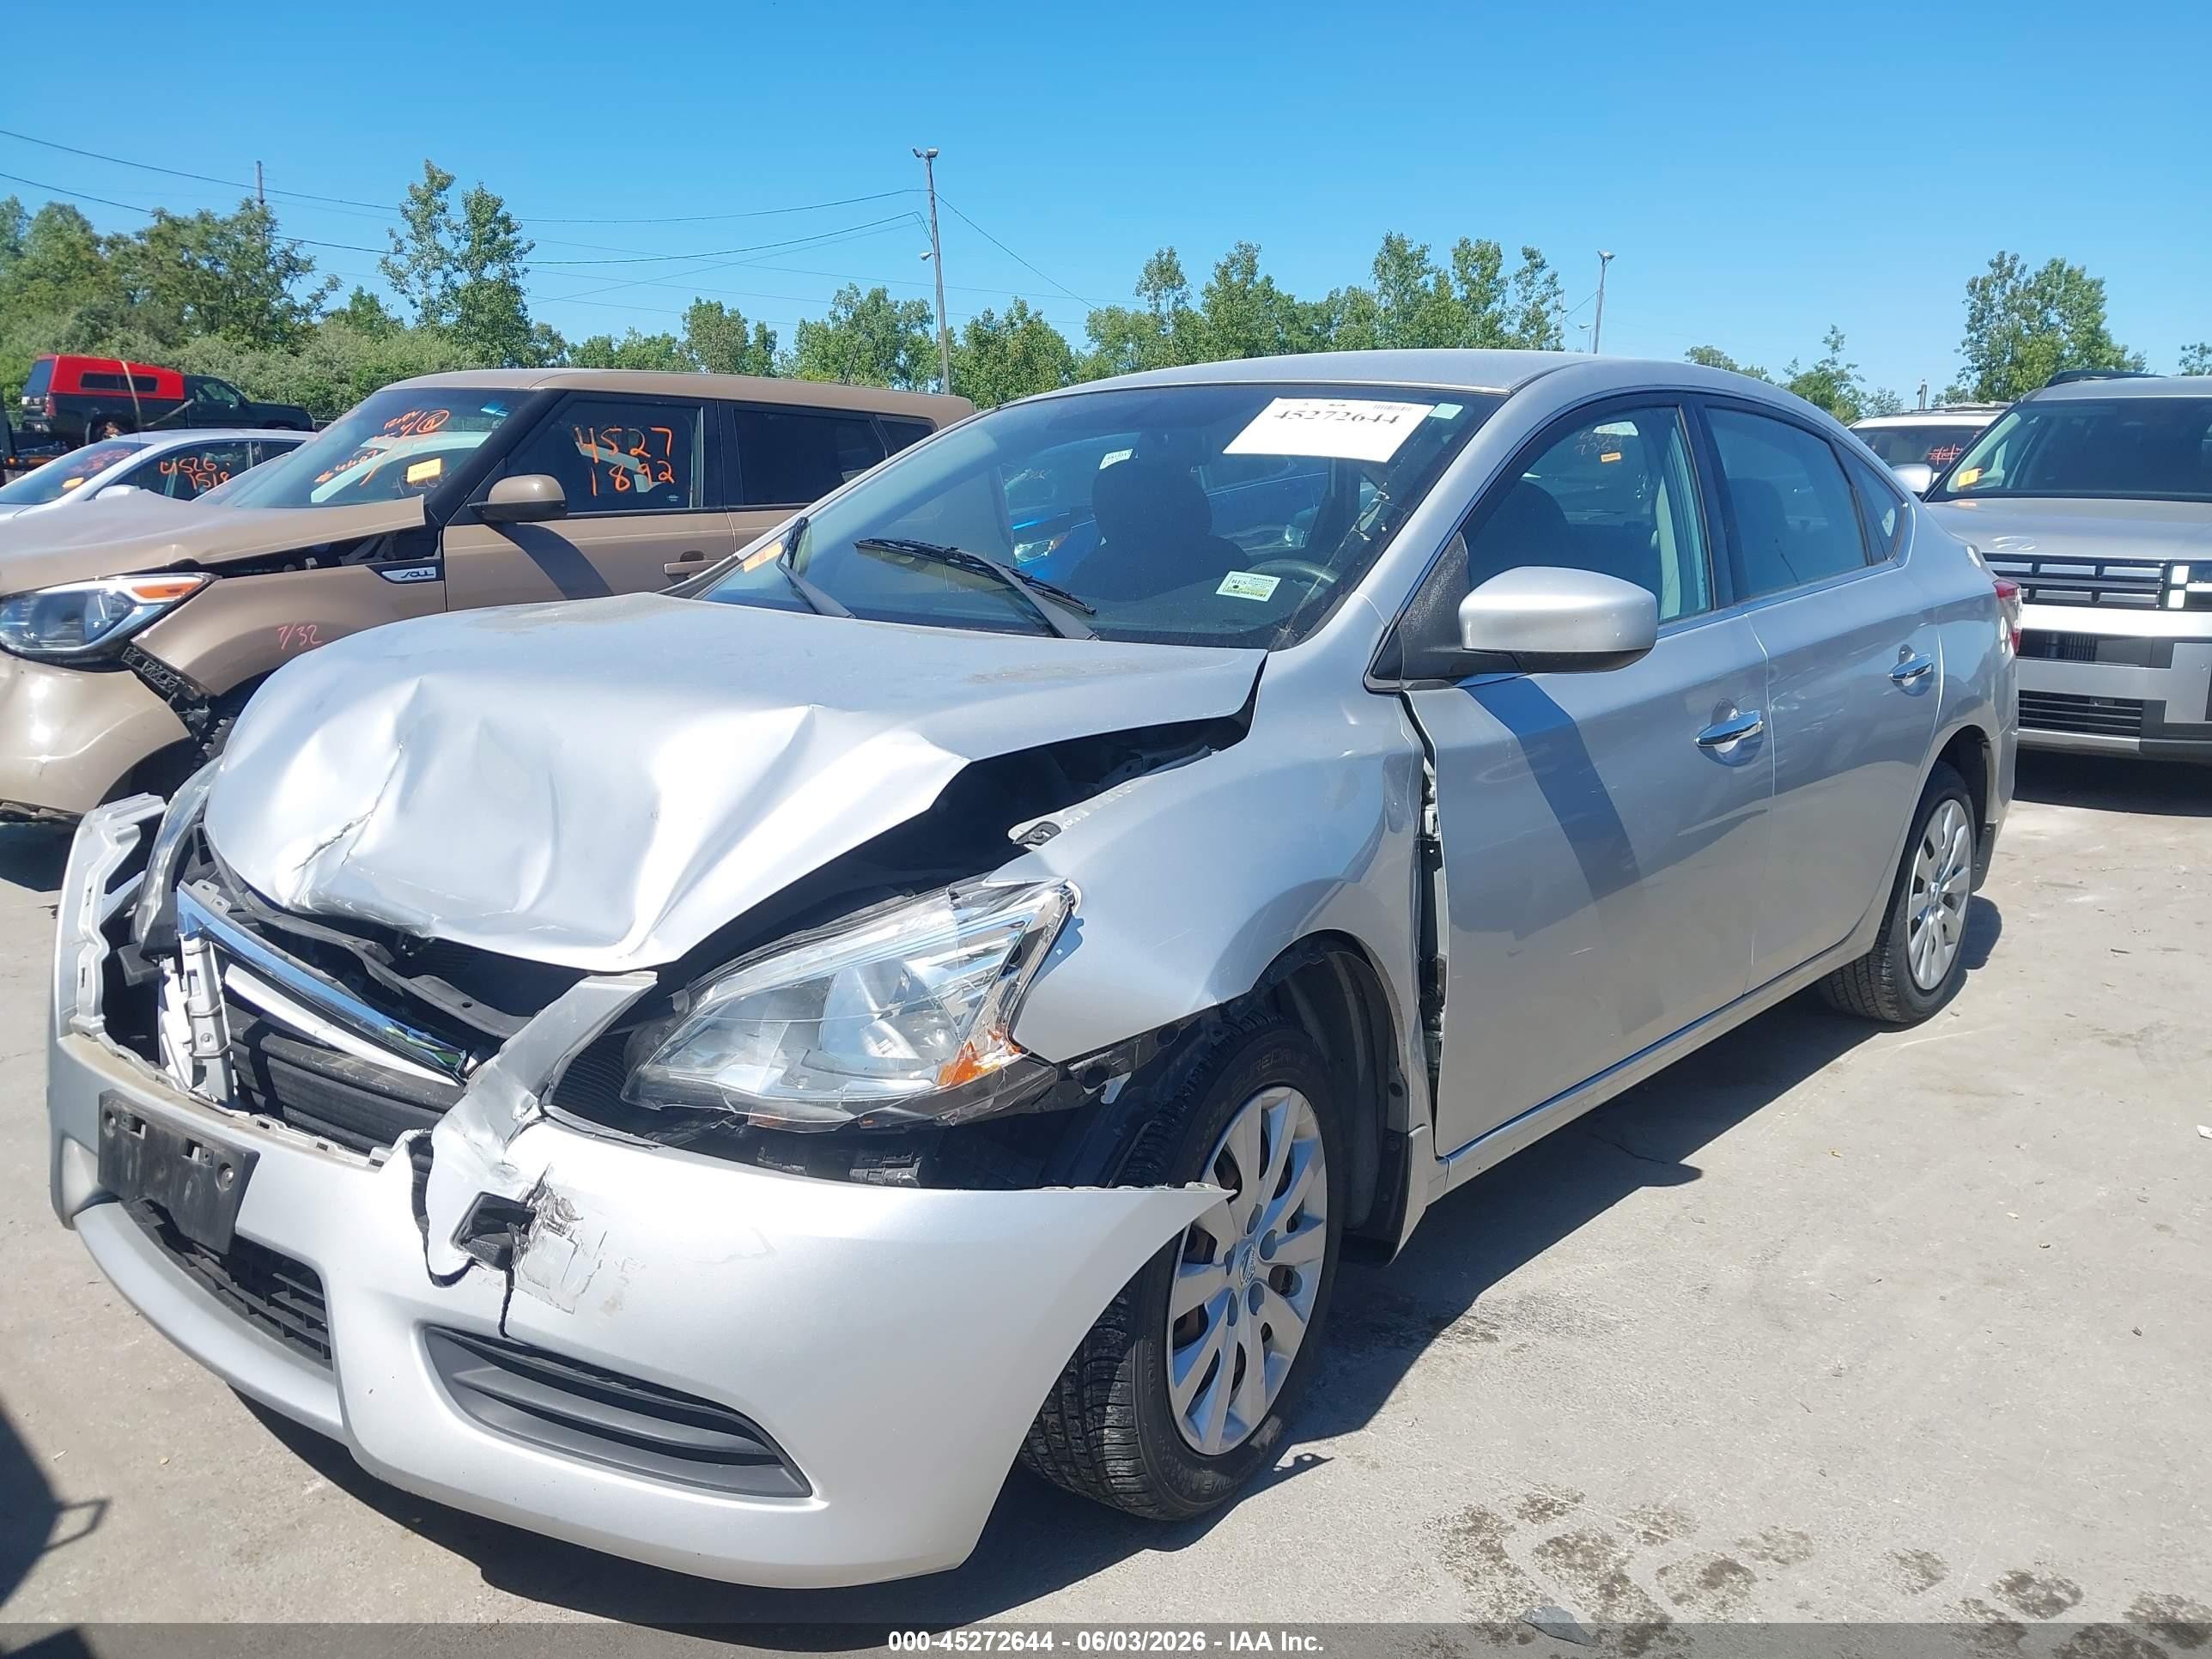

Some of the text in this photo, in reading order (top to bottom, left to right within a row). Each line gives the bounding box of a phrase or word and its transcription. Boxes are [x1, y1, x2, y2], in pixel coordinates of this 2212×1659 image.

[1274, 410, 1401, 425] 45272644
[574, 427, 673, 464] 4527
[160, 457, 217, 476] 4526
[590, 459, 675, 496] 1892
